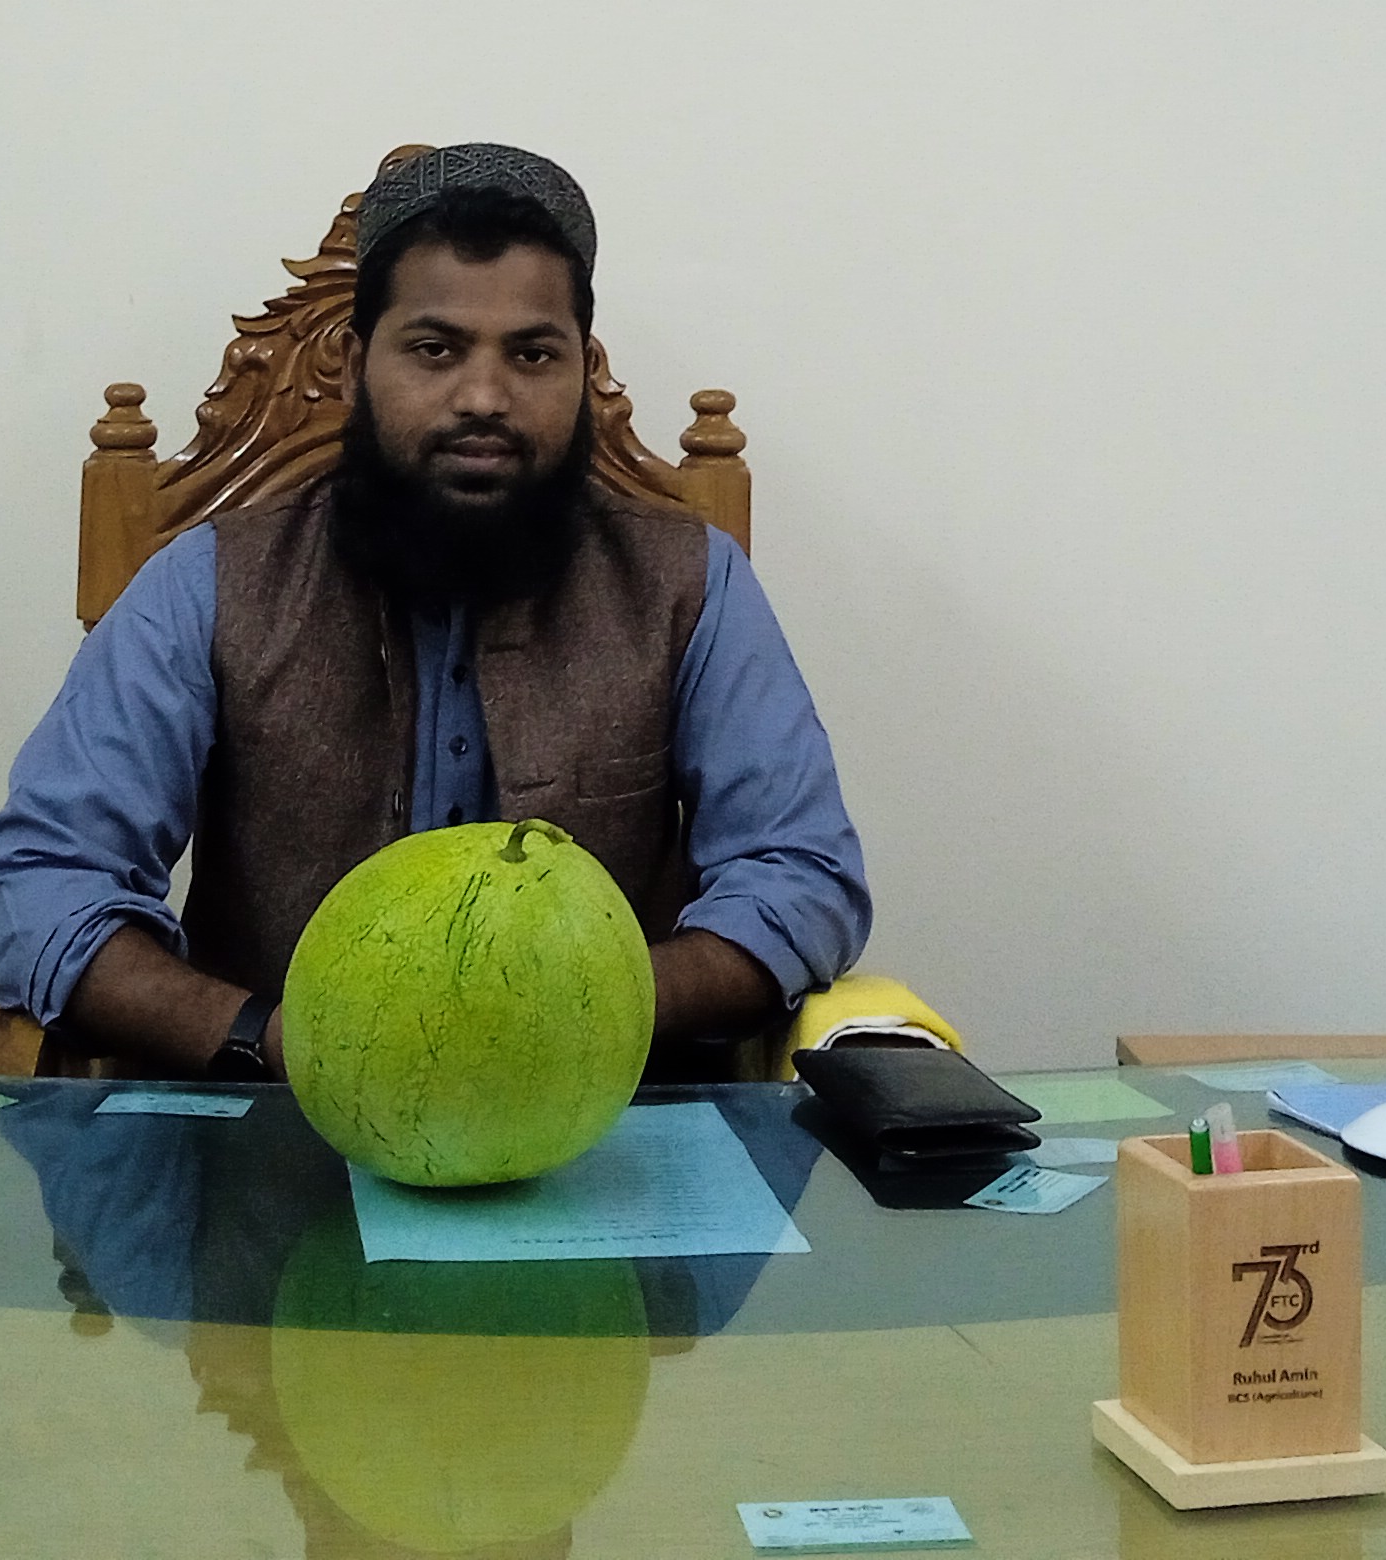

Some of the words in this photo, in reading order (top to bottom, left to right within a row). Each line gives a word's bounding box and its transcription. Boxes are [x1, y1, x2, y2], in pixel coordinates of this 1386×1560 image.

[1271, 1294, 1300, 1308] FTC
[1233, 1369, 1276, 1385] Ruhul
[1279, 1368, 1318, 1382] Amin
